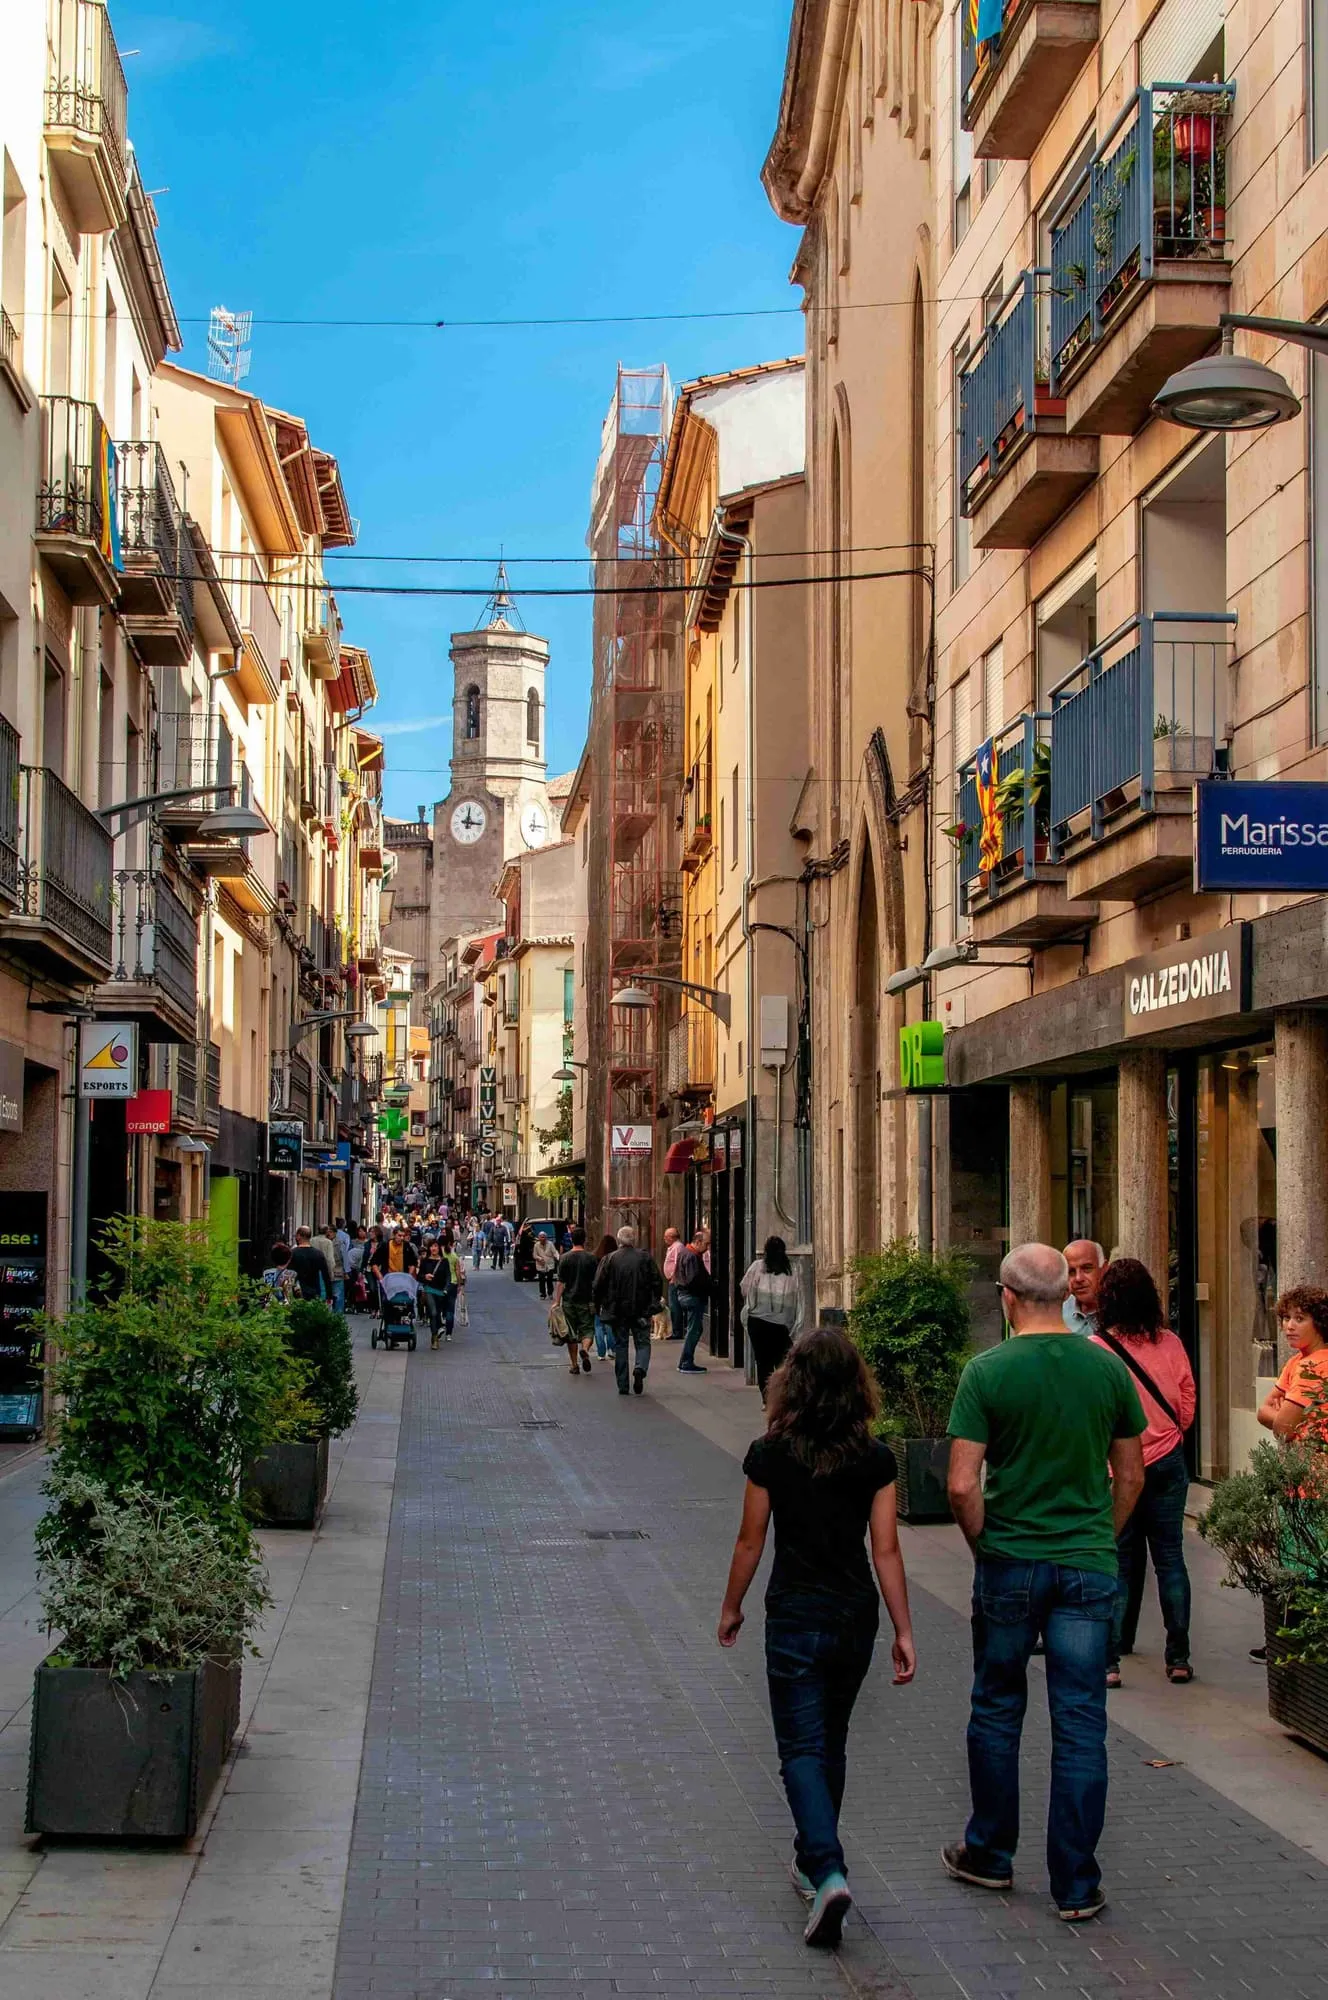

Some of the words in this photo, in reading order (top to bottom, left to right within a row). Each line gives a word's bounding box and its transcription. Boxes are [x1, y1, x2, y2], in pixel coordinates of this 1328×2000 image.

[1221, 814, 1328, 846] Marissa
[1221, 847, 1283, 856] PERRUQUERIA
[1130, 949, 1231, 1015] CALZEDONIA
[83, 1081, 128, 1090] ESPORTS
[481, 1068, 495, 1157] VIVES
[128, 1121, 165, 1132] orange
